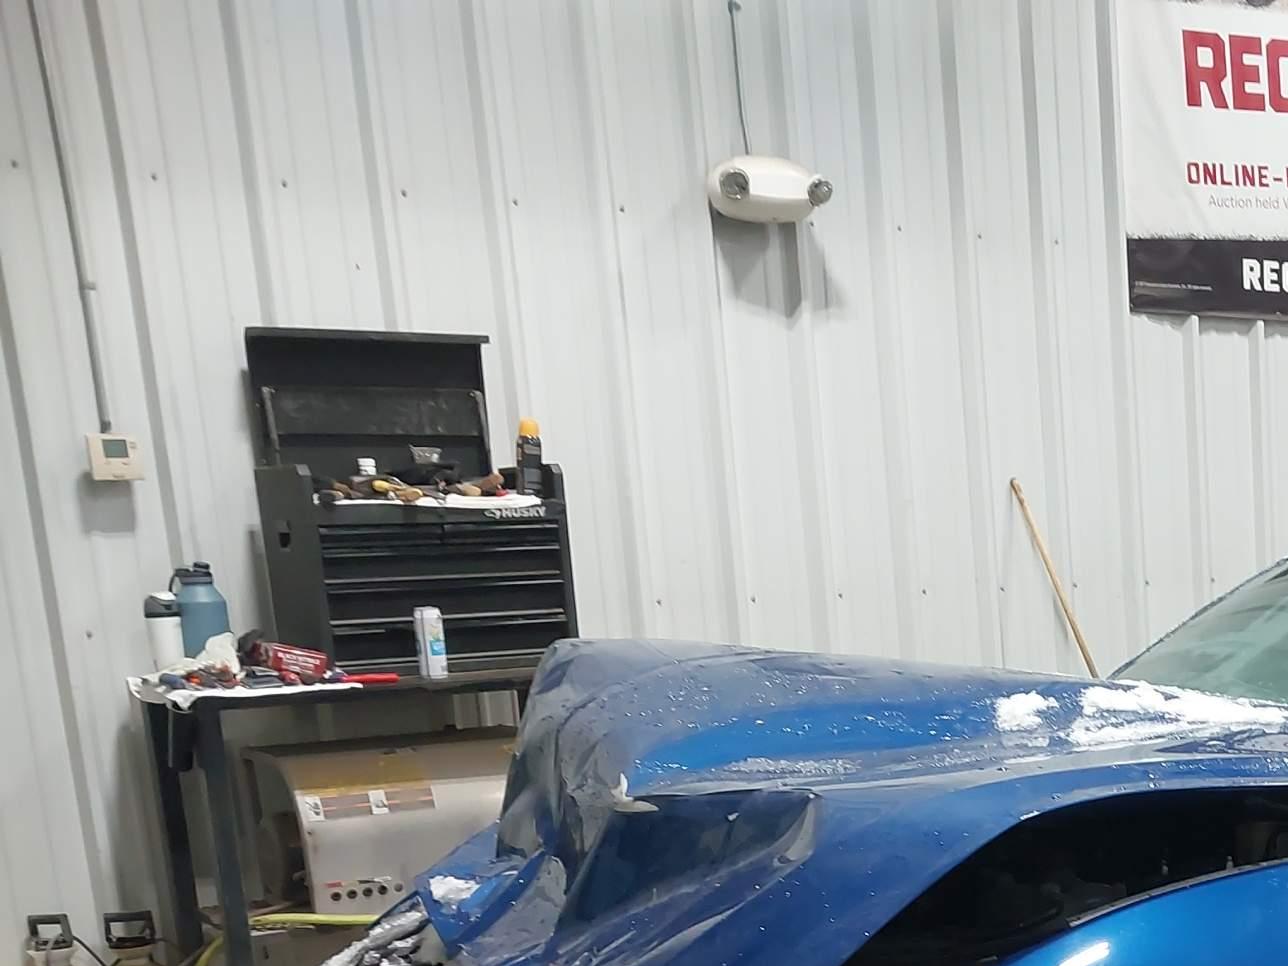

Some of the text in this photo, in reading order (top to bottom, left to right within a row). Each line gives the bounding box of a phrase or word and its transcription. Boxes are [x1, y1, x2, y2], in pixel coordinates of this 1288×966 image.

[1208, 195, 1252, 211] Auction
[1255, 197, 1279, 211] held
[501, 506, 546, 518] HUSKY
